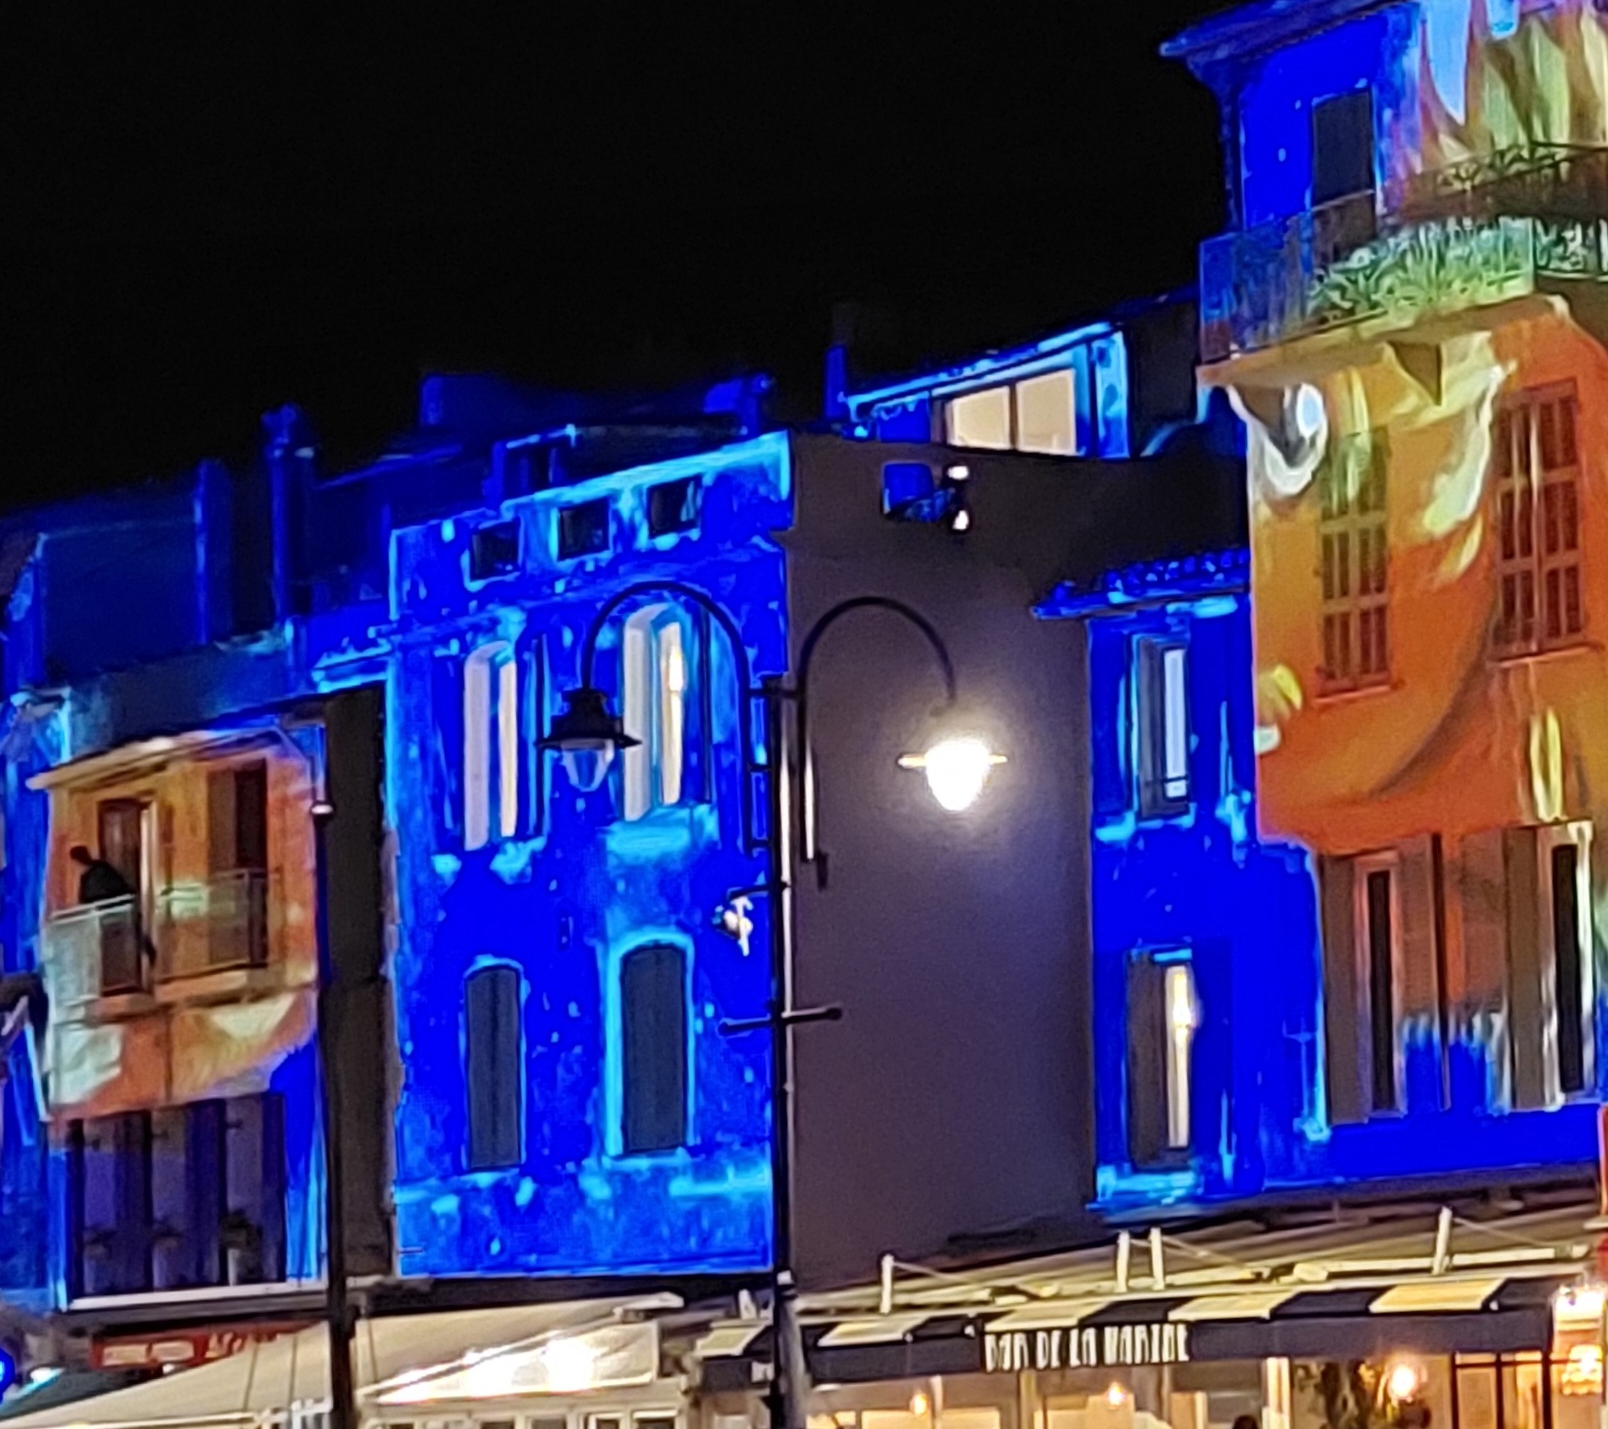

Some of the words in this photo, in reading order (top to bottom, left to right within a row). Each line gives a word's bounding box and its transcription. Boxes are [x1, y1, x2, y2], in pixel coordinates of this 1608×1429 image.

[984, 1332, 1029, 1372] BAR
[1036, 1329, 1062, 1369] DE
[1069, 1328, 1097, 1367] LA
[1104, 1323, 1190, 1365] MARINE
